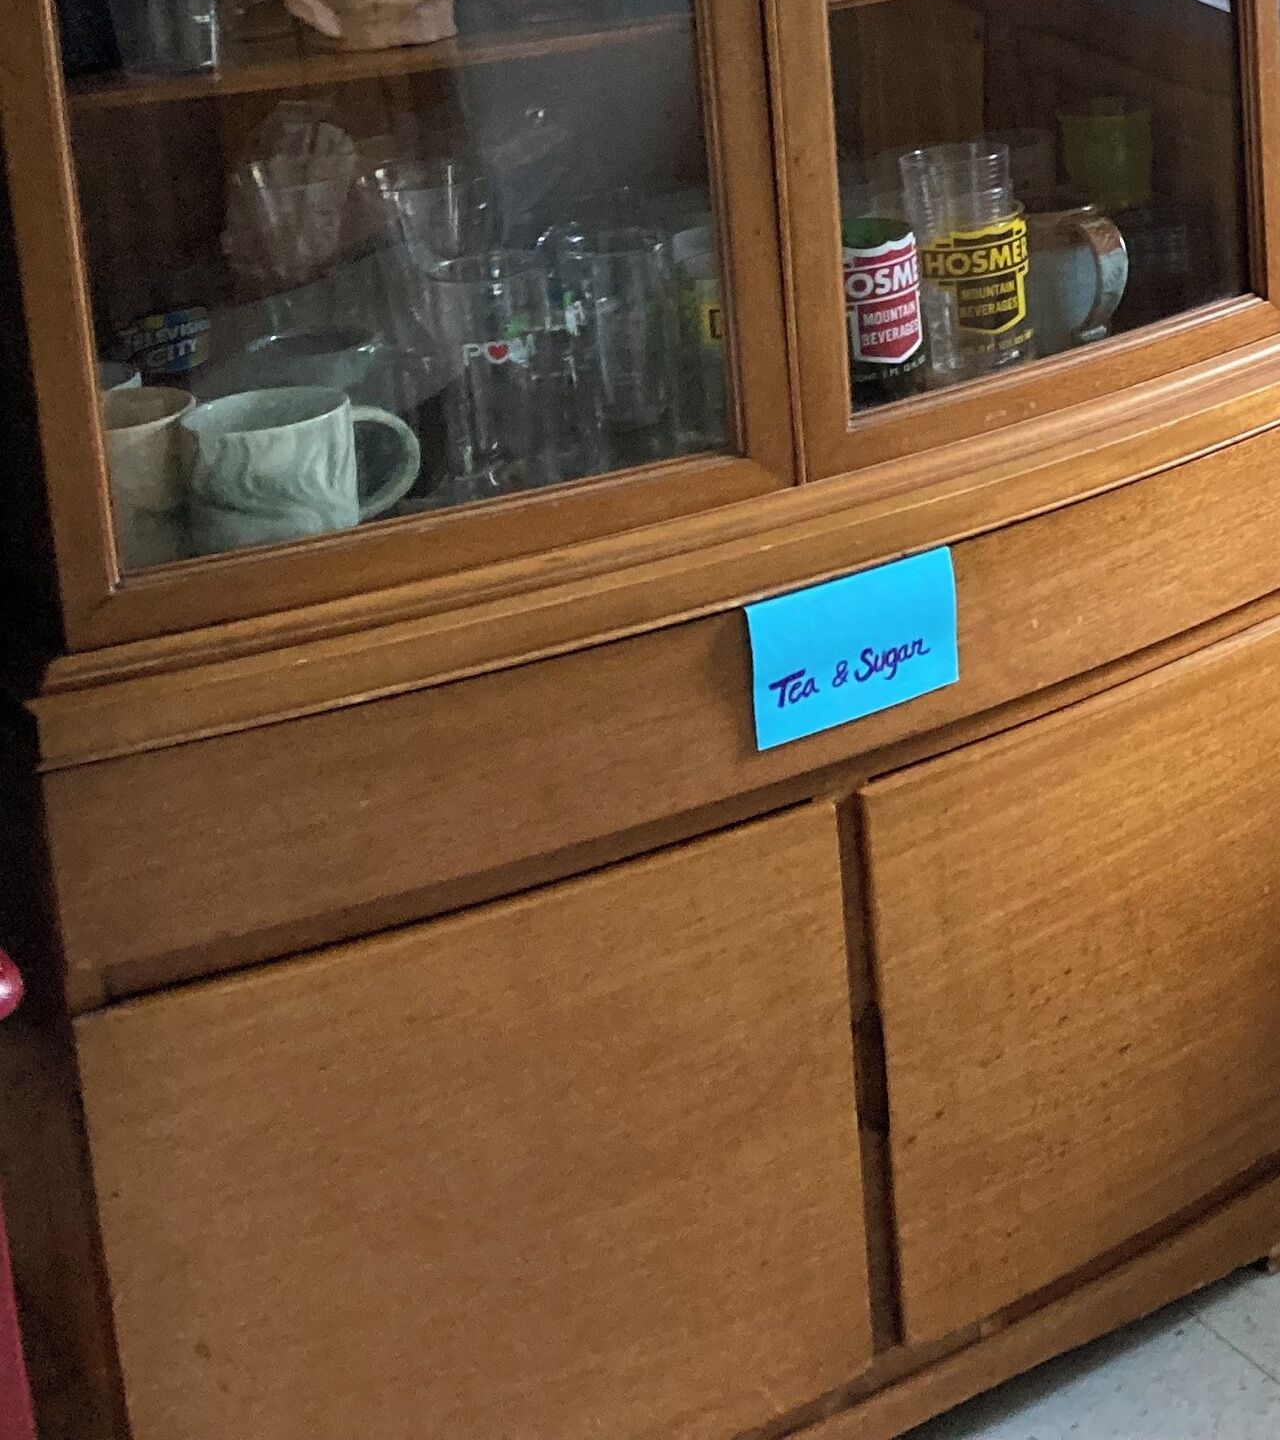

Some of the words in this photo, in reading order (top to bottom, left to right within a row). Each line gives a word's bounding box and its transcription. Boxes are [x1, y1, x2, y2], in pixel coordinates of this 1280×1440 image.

[924, 238, 1028, 276] HOSMER
[846, 255, 919, 298] OSME
[961, 280, 1015, 300] MOUNTAIN
[863, 302, 916, 326] MOUNTAIN
[960, 297, 1018, 317] BEVERAGES
[862, 319, 919, 347] BEVERAGES
[768, 668, 820, 709] Tea
[832, 659, 849, 688] &
[854, 637, 931, 683] Sugar
